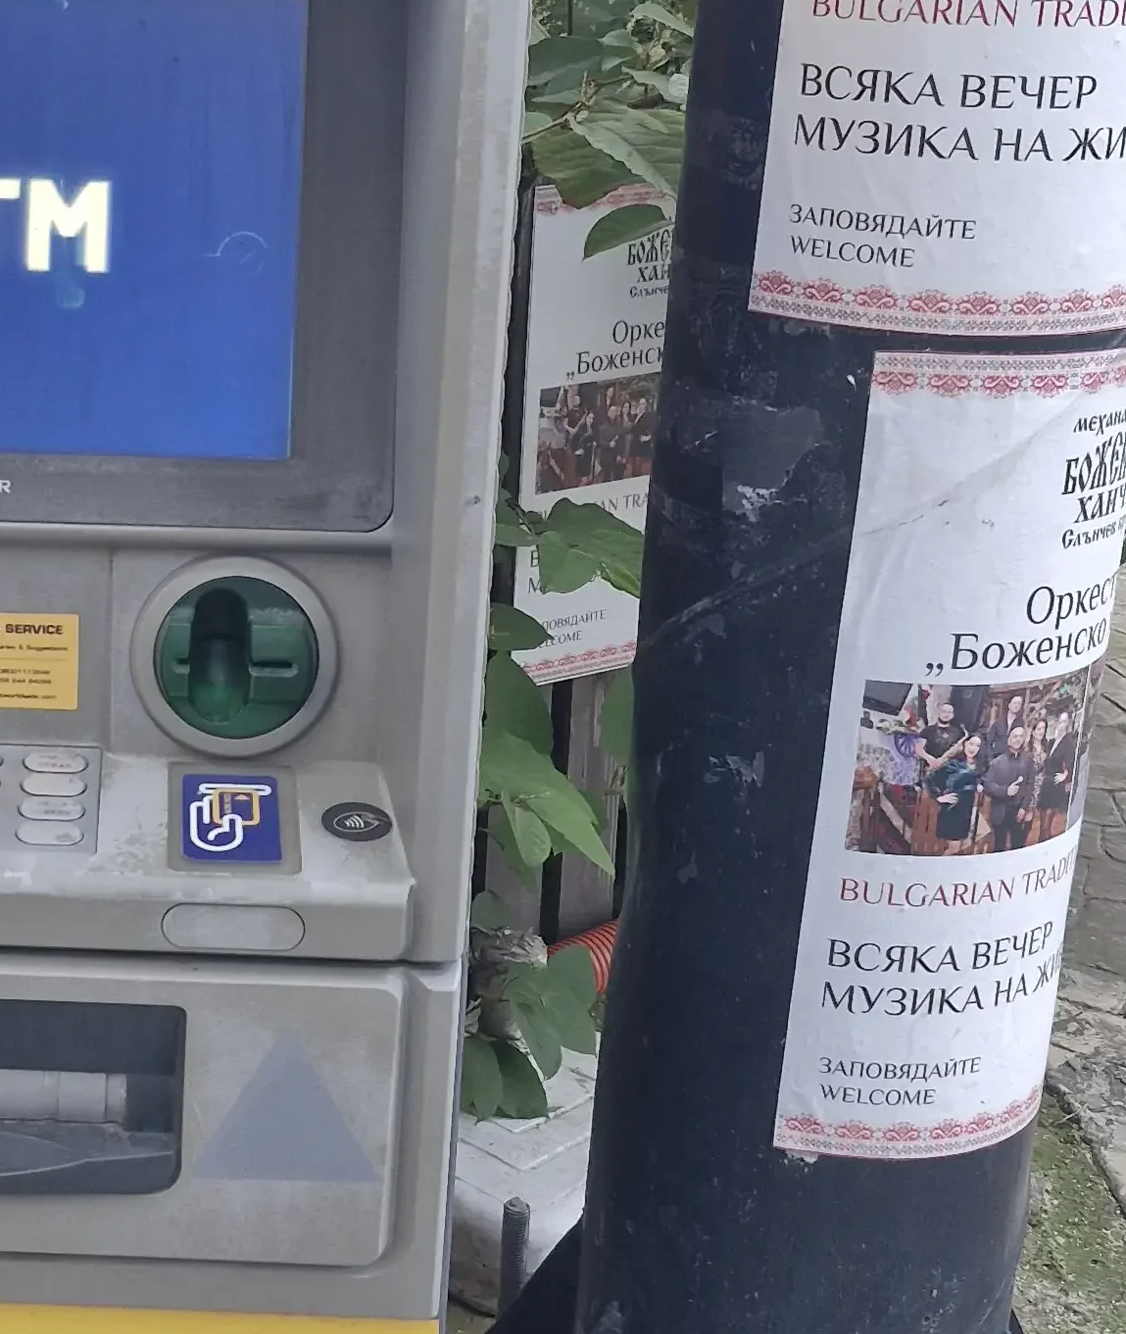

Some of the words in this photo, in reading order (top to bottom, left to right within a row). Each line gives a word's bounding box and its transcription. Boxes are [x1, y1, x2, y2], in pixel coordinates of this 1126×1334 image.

[800, 63, 945, 107] ВСЯКА
[959, 74, 1098, 110] ВЕЧЕР
[793, 114, 979, 161] МУЗИКА
[993, 128, 1054, 162] НА
[789, 204, 977, 240] ЗАПОВЯДАЙТЕ
[790, 236, 916, 268] WELCOME
[612, 320, 665, 347] Орке
[5, 623, 63, 635] SERVICE
[839, 876, 1014, 908] BULGARIAN
[827, 938, 961, 973] ВСЯКА
[971, 921, 1054, 970] ВЕЧЕР
[821, 981, 984, 1016] МУЗИКА
[993, 973, 1029, 1007] НА
[819, 1055, 982, 1082] ЗАПОВЯДАЙТЕ
[820, 1083, 937, 1106] WELCOME
